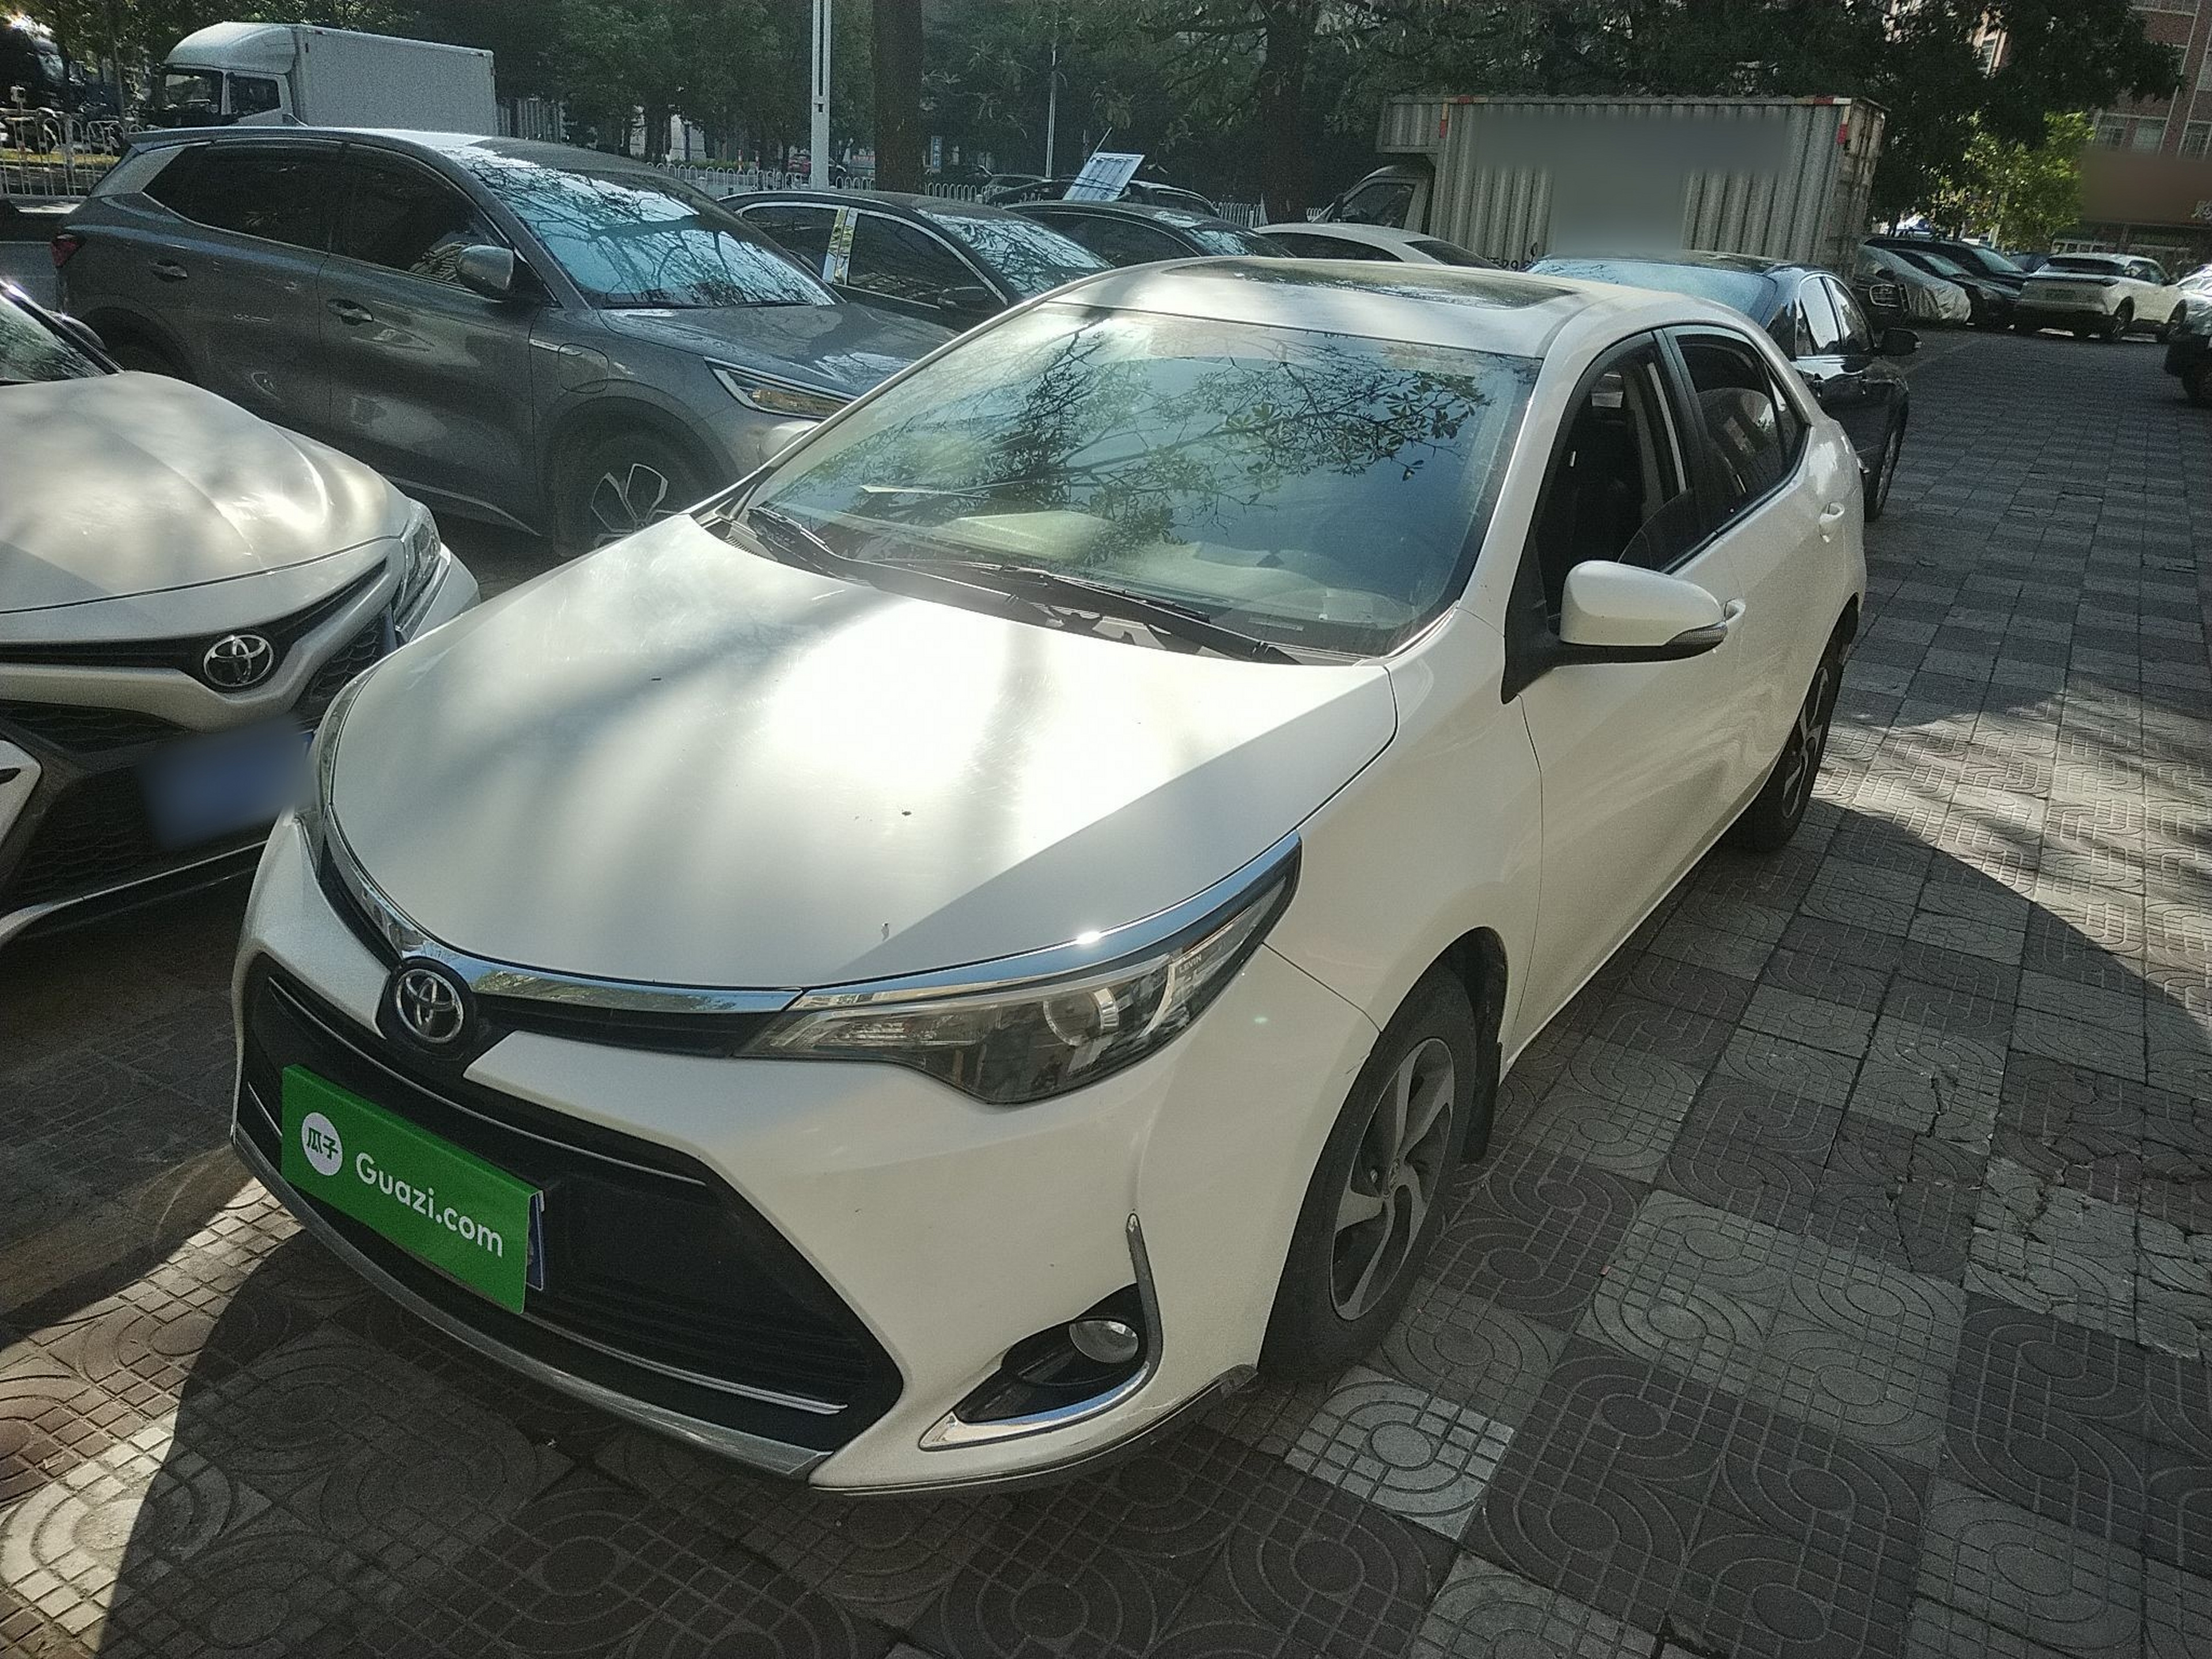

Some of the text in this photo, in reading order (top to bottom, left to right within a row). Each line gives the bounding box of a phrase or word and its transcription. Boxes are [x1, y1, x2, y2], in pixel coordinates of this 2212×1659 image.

[1179, 953, 1202, 973] LEVIN
[306, 1127, 339, 1160] 瓜子
[356, 1153, 503, 1257] Guazi.com
